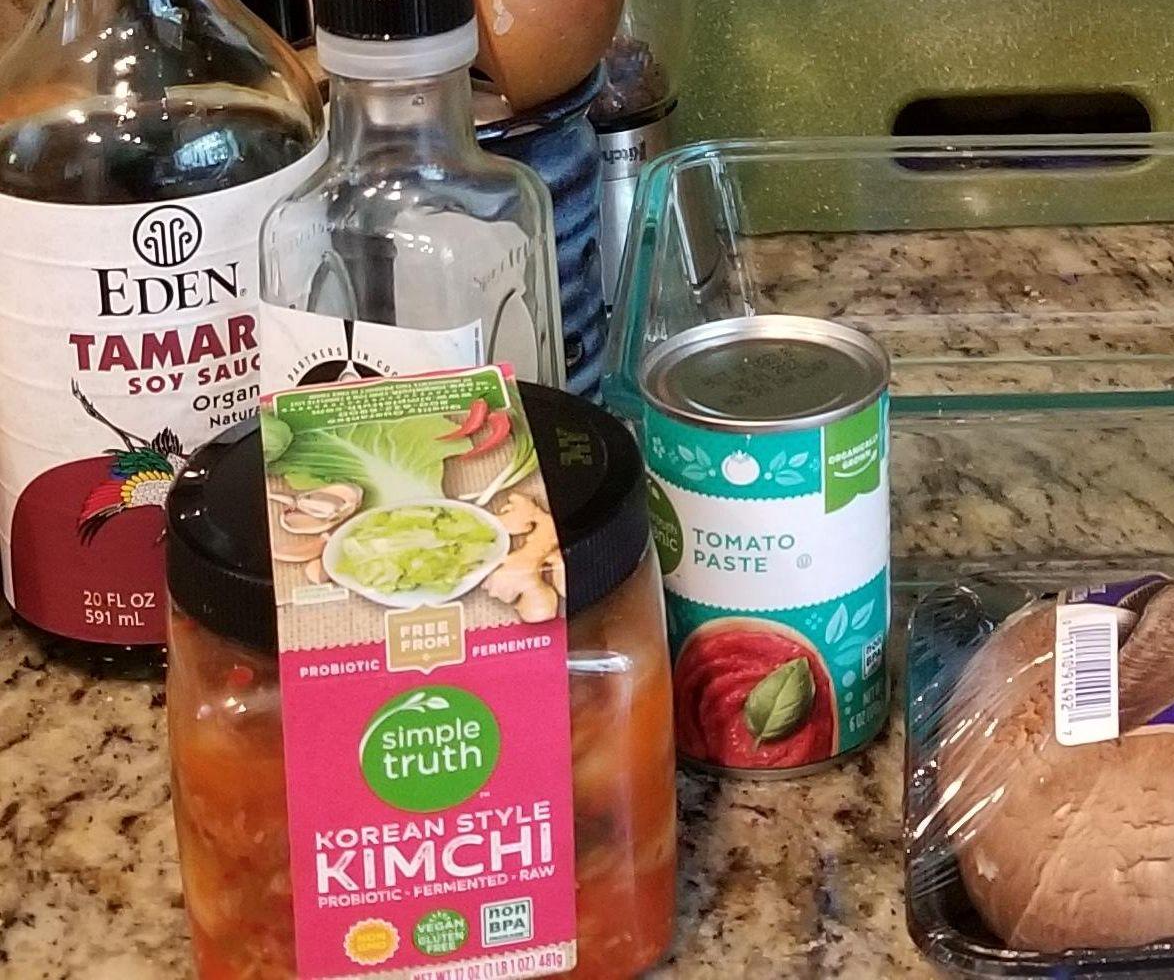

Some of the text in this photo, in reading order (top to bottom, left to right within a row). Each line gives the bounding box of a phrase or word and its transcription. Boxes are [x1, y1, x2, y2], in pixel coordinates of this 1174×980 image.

[91, 262, 240, 317] EDEN
[69, 314, 257, 372] TAMAR
[287, 347, 342, 382] PARTNERS
[128, 373, 184, 396] SOY
[193, 384, 260, 411] Organ
[692, 527, 795, 551] TOMATO
[694, 550, 768, 573] PASTE
[83, 590, 156, 608] 20 FL OZ
[85, 608, 145, 626] 591 mL
[400, 620, 450, 638] FREE
[400, 634, 450, 653] FROM
[299, 635, 552, 678] PROBIOTIC FERMENTED
[382, 717, 481, 750] simple
[382, 741, 483, 780] truth
[315, 800, 552, 851] KOREAN STYLE
[315, 821, 553, 894] KIMCHI
[317, 864, 556, 909] PROBIOTIC FERMENTED RAW
[488, 903, 526, 919] non
[416, 919, 465, 934] VEGAN
[489, 917, 526, 934] BPA
